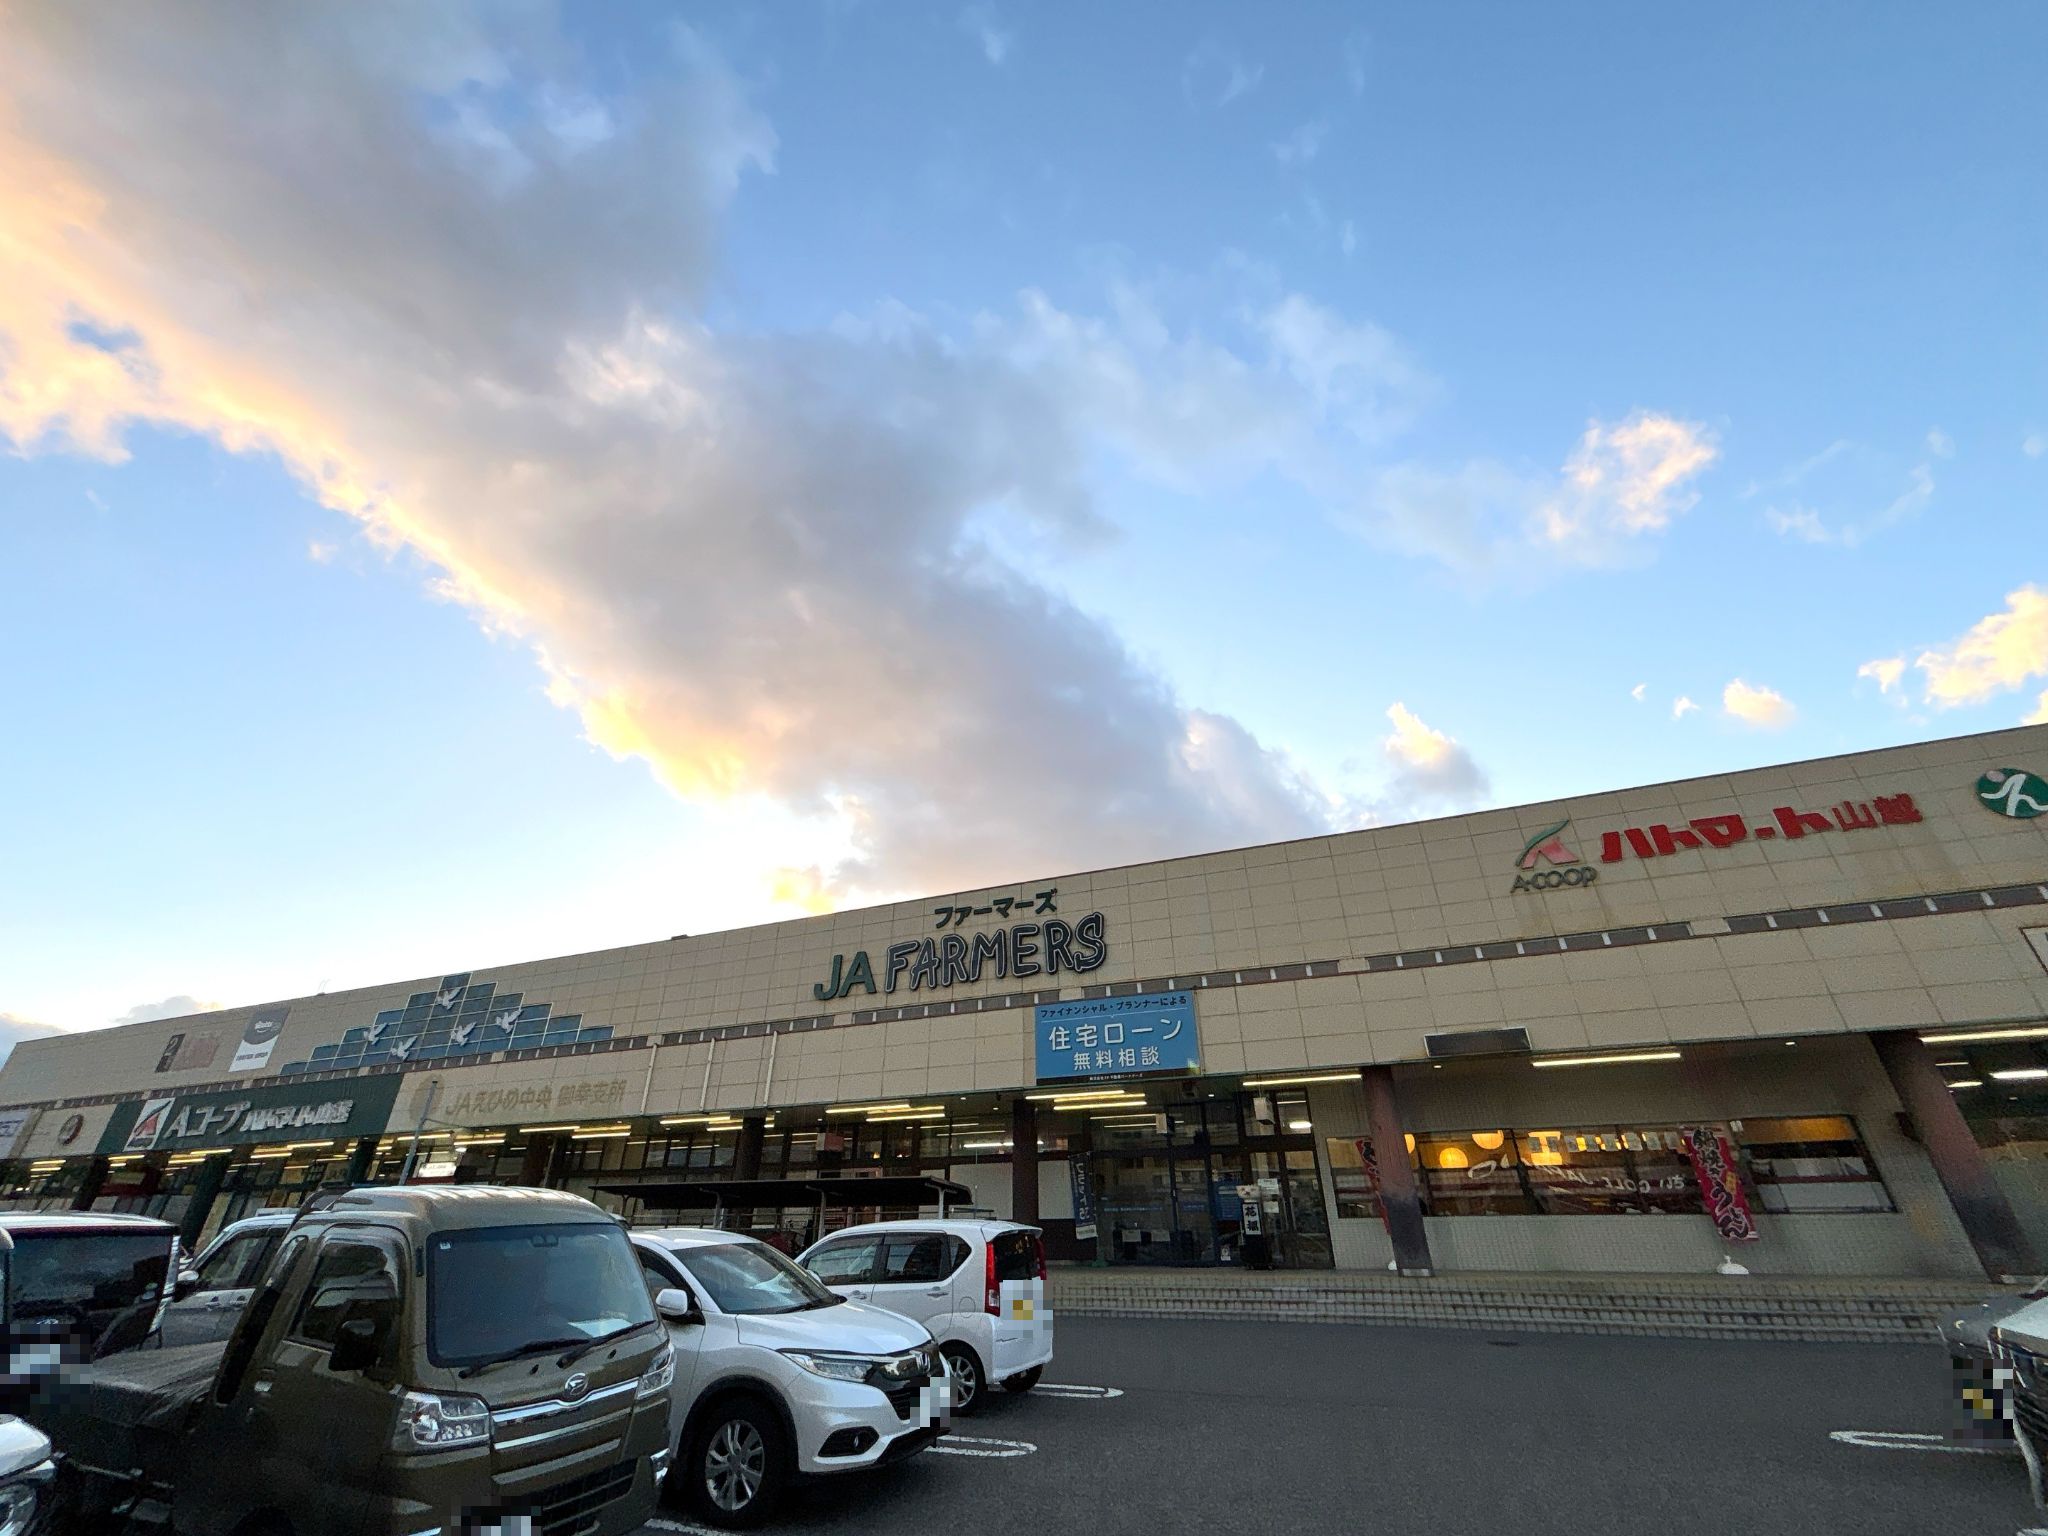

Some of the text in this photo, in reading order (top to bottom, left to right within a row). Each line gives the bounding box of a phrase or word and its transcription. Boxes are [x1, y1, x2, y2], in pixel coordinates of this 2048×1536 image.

[934, 888, 1058, 929] ファーマーズ
[813, 911, 1107, 1000] JA FARMERS
[1049, 1018, 1182, 1051] 住宅ローン
[1073, 1046, 1160, 1071] 無料相談
